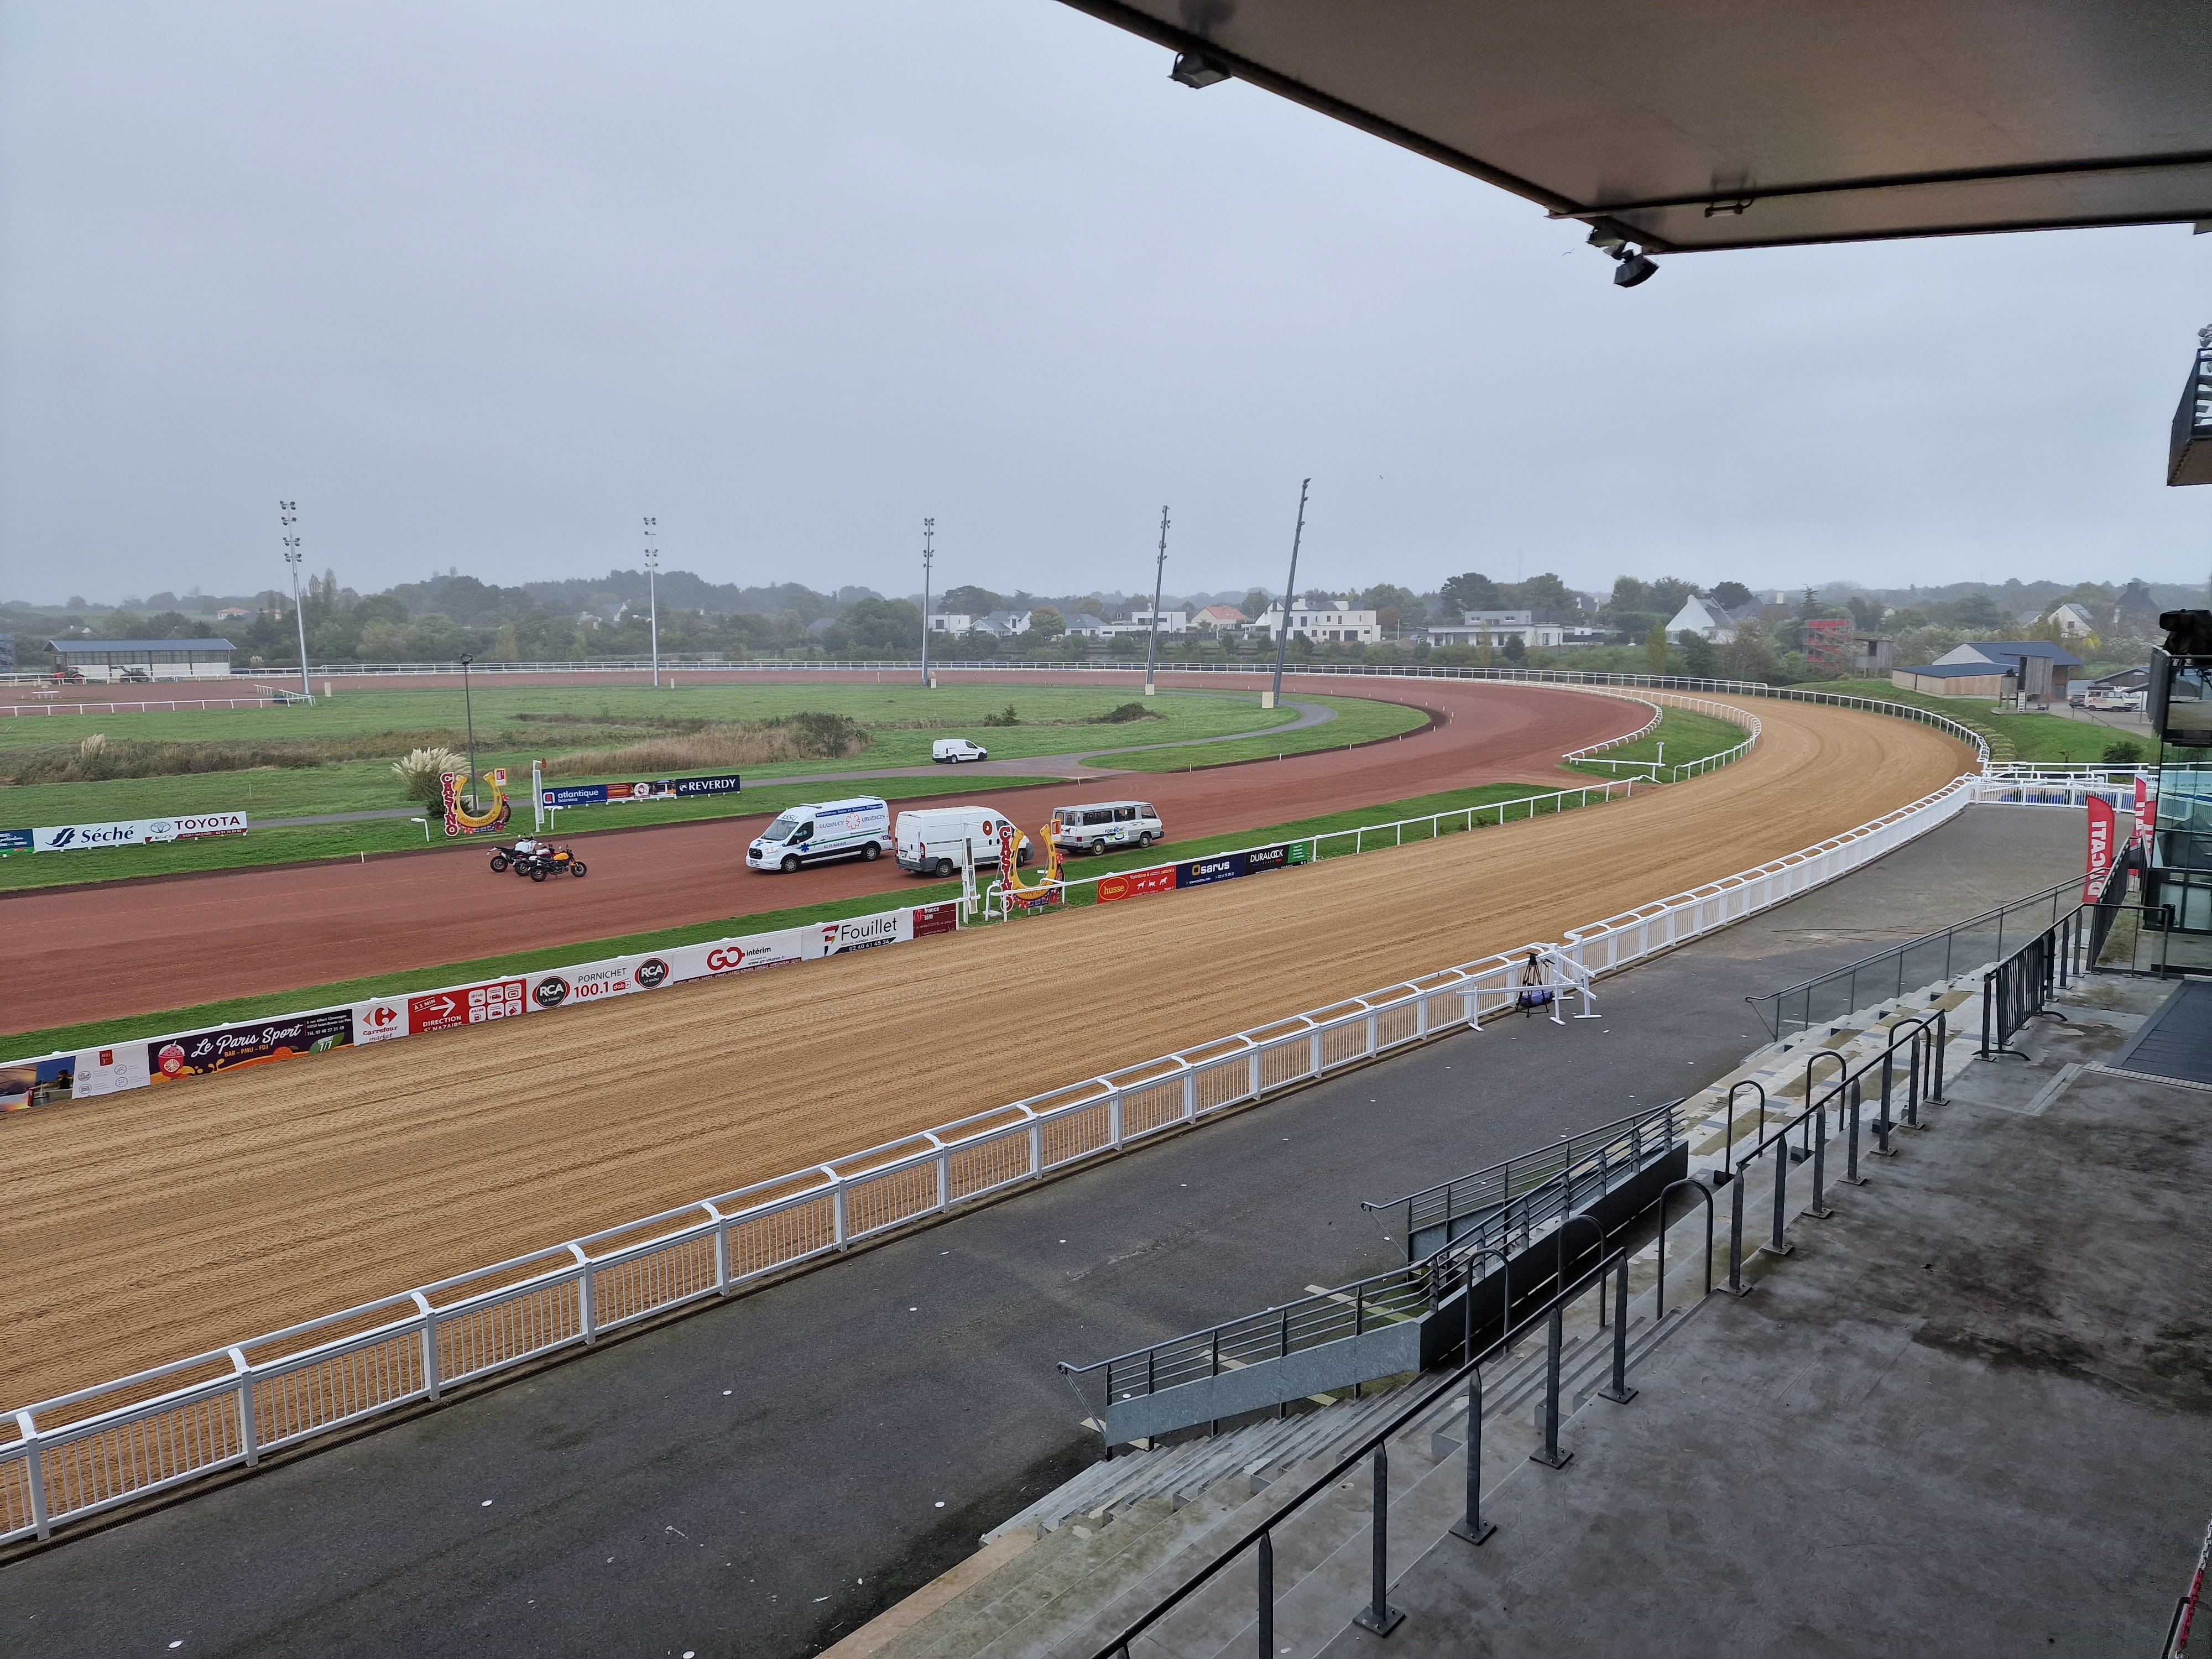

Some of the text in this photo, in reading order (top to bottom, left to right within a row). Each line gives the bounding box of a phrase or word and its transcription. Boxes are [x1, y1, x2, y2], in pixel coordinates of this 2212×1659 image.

[688, 779, 737, 791] REVERDY
[557, 789, 598, 799] atlantique
[441, 773, 458, 836] CASINO
[174, 816, 241, 830] TOYOTA
[461, 812, 498, 825] PORNICHET
[818, 821, 844, 829] SANSOUCY
[81, 826, 134, 843] Séché
[1250, 848, 1284, 863] DURALOCK
[1192, 861, 1230, 876] Osarus
[1103, 885, 1125, 895] husse
[841, 917, 897, 941] Fouillet
[707, 946, 745, 971] GO
[747, 946, 771, 957] intérim
[578, 968, 627, 983] PORNICHET
[641, 964, 664, 978] RCA
[539, 983, 565, 997] RCA
[573, 981, 609, 999] 100.1
[422, 1015, 462, 1027] DIRECTION
[363, 1026, 399, 1036] Carrefour
[369, 1033, 393, 1042] market
[190, 1024, 304, 1058] Le Paris Sport
[317, 1035, 334, 1044] OUVERT
[319, 1041, 332, 1052] 7/7
